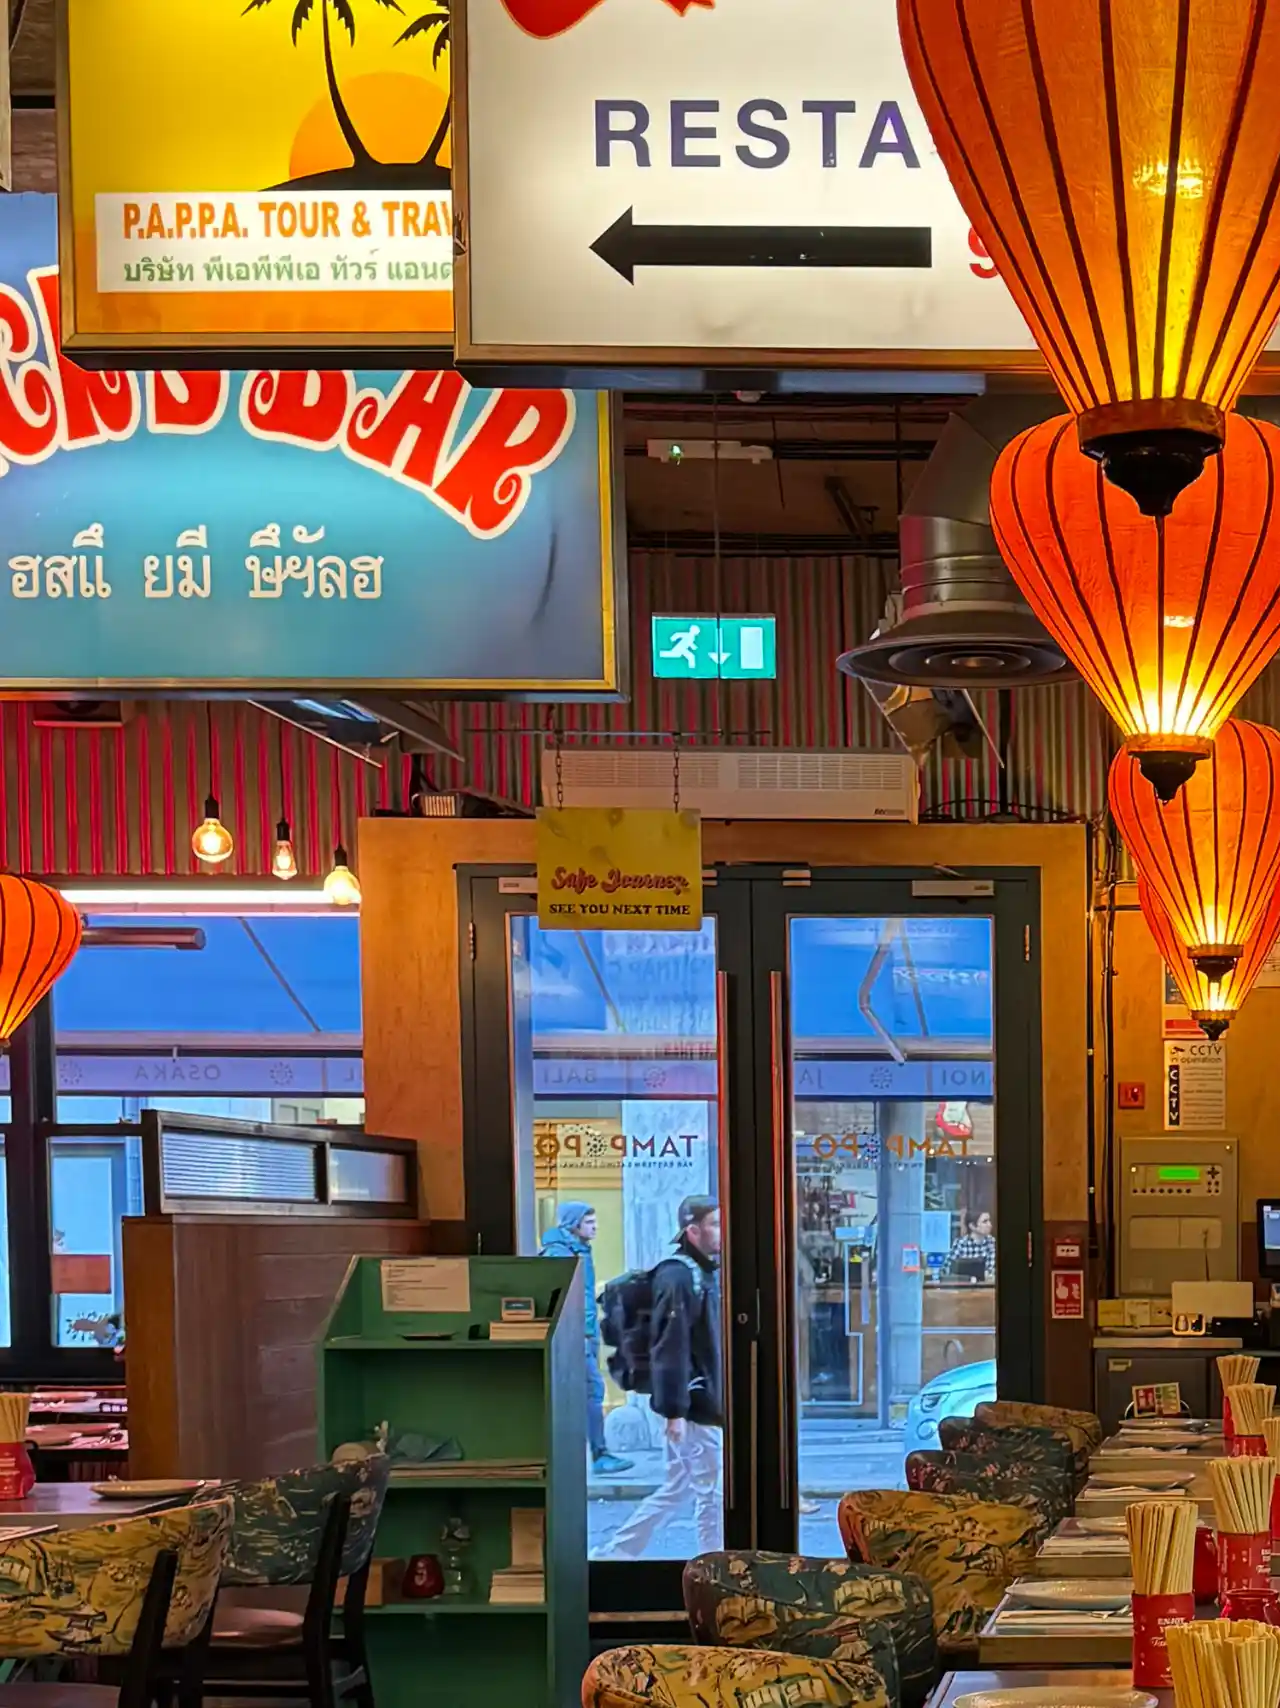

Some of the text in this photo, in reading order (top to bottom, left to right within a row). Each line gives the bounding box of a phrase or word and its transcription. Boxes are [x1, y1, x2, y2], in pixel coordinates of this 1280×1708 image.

[123, 201, 249, 239] P.A.P.P.A.
[258, 201, 341, 238] TOUR
[351, 201, 372, 237] &
[123, 256, 194, 282] บริษัท
[203, 254, 321, 282] พีเอพีพีเอ
[331, 248, 380, 282] ทัวร์
[551, 866, 690, 896] Safe Journey
[549, 903, 691, 916] SEE YOU NEXT TIME
[1189, 1044, 1222, 1056] CCTV
[1169, 1069, 1179, 1121] CCTV
